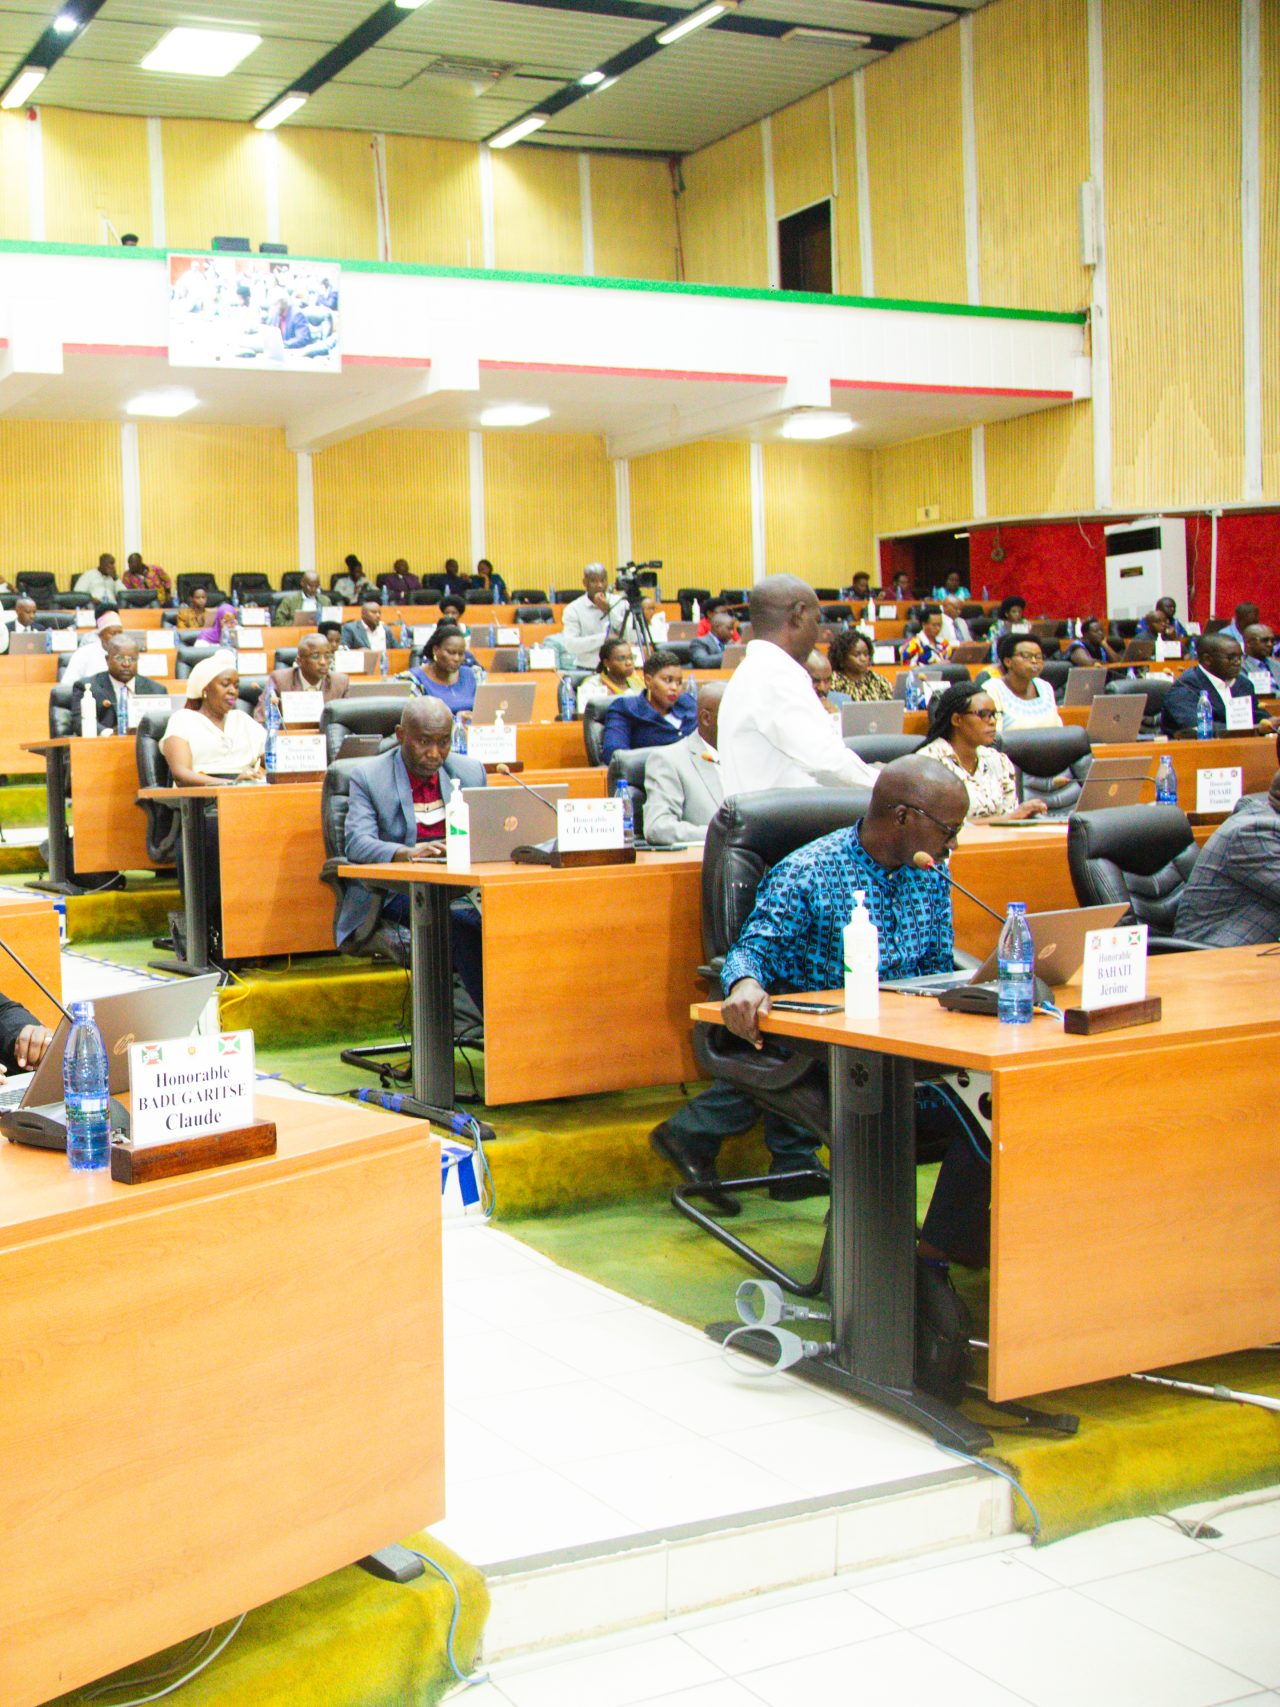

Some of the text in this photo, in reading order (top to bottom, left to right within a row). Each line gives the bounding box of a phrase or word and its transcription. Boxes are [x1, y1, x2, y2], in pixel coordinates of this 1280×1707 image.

[1099, 950, 1131, 964] Honorable
[1098, 963, 1132, 980] BAHATI
[156, 1065, 231, 1088] Honorable
[139, 1083, 246, 1111] BADUGARITSE
[165, 1107, 222, 1131] Claude
